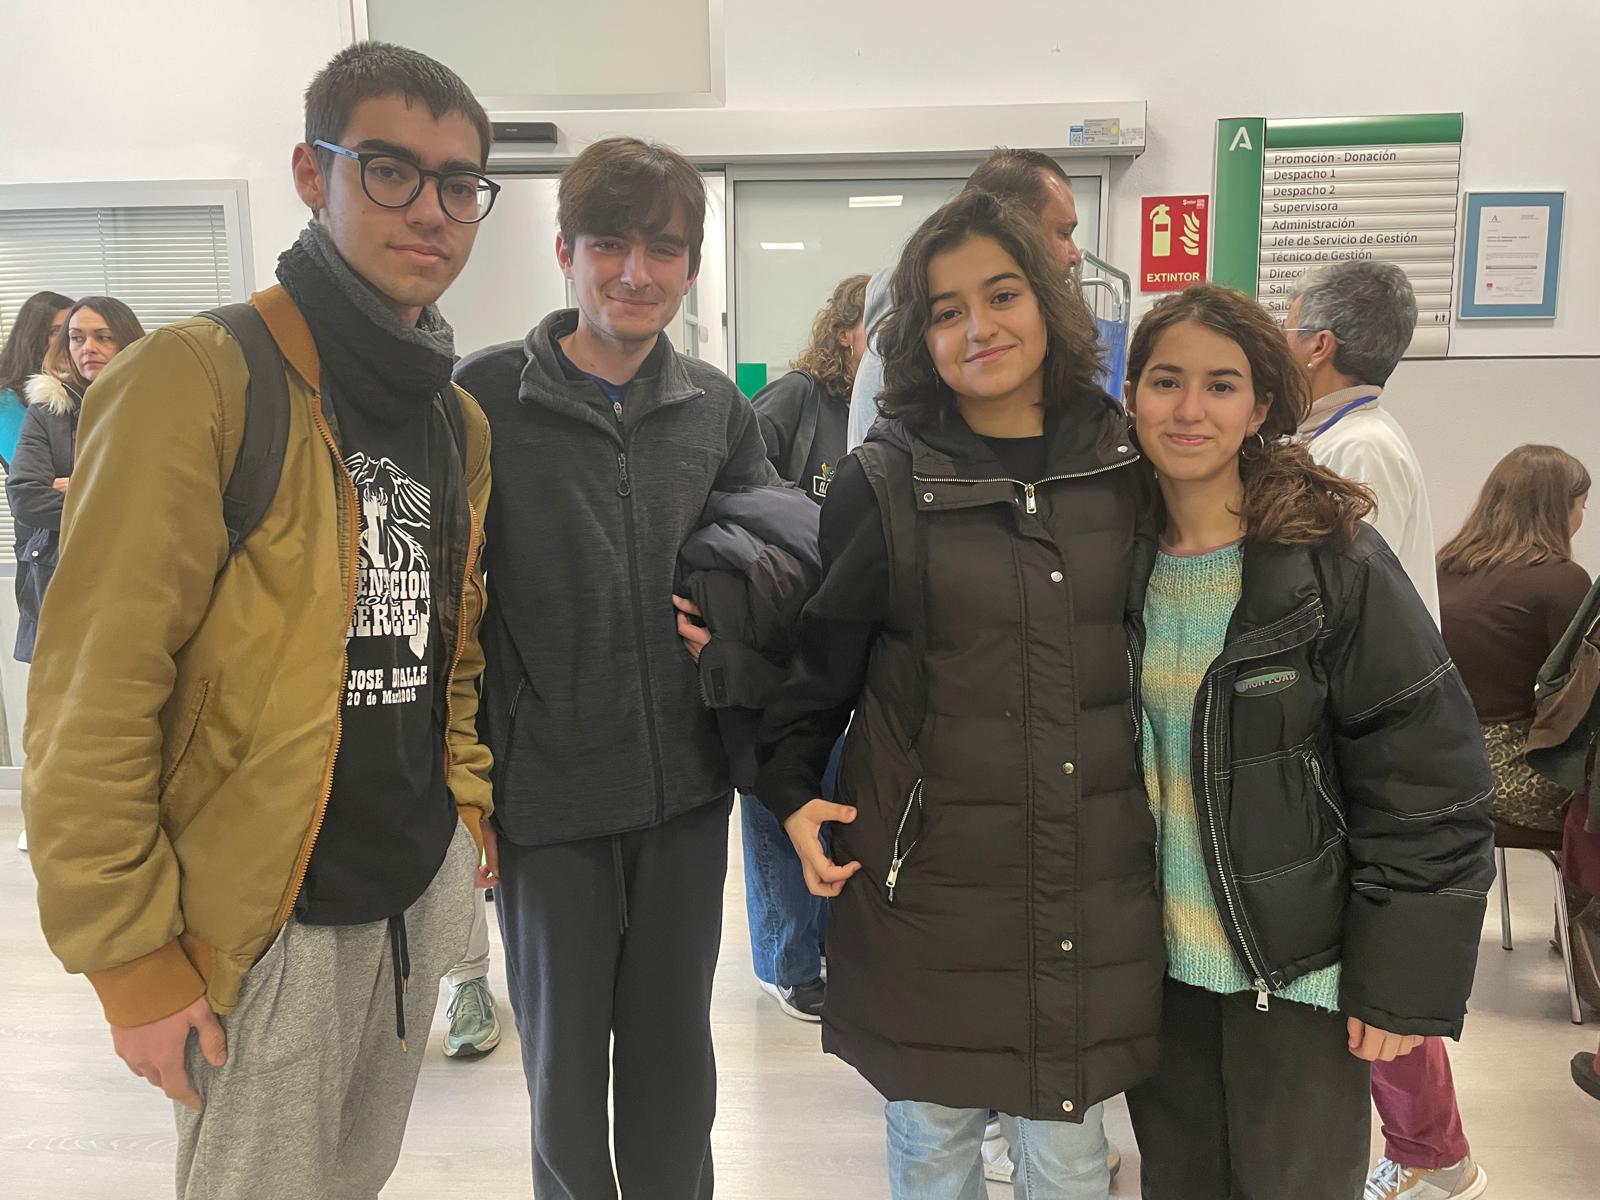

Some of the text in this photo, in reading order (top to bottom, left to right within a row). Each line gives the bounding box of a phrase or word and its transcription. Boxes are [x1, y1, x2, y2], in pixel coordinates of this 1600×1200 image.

[1274, 152, 1335, 165] Promoción
[1344, 149, 1397, 162] Donación
[1273, 169, 1336, 181] Despacho 1
[1273, 185, 1336, 197] Despacho 2
[1272, 201, 1338, 214] Supervisora
[1271, 217, 1355, 230] Administración
[1271, 232, 1418, 247] Jefe de Servicio de Gestión
[1271, 248, 1372, 262] Técnico de Gestión
[1146, 272, 1200, 283] EXTINTOR
[347, 668, 384, 691] JOSE
[346, 691, 361, 706] 20
[366, 691, 377, 706] de
